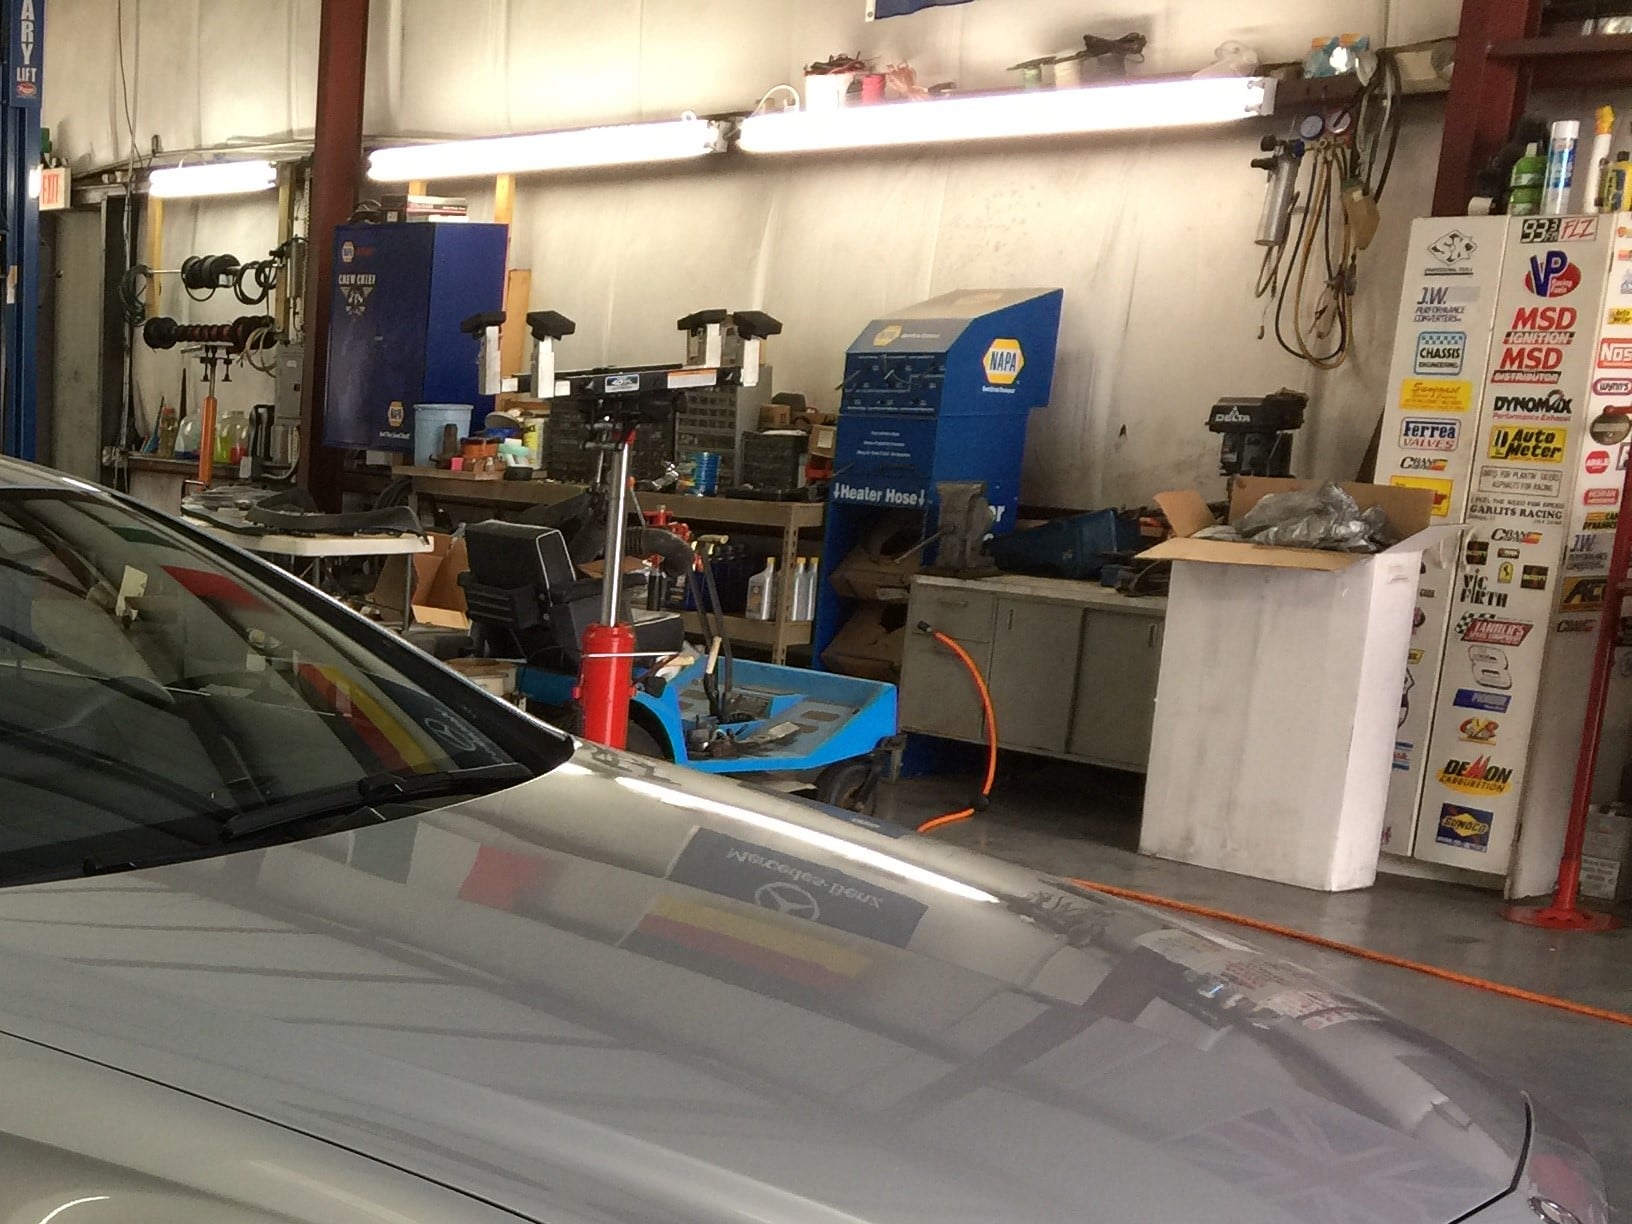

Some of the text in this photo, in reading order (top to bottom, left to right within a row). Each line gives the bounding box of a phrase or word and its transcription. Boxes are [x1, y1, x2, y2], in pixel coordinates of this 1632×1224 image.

[16, 67, 38, 82] LIFT
[42, 174, 59, 205] EXIT
[1529, 249, 1568, 298] VP
[1511, 306, 1578, 331] MSD
[1508, 332, 1570, 345] IGNITION
[989, 351, 1017, 372] NAPA
[1419, 347, 1461, 359] CHASSIS
[1499, 347, 1563, 370] MSD
[1493, 390, 1574, 414] DYNOMAX
[1215, 411, 1251, 423] DELTA
[1403, 420, 1457, 439] Ferrea
[1511, 428, 1556, 444] Auto
[1403, 438, 1455, 449] VALVES
[1506, 443, 1562, 459] Meter
[841, 484, 918, 505] Heater Hose
[1470, 504, 1562, 519] GARLITS RACING
[1460, 588, 1508, 608] FIRTH
[1443, 753, 1513, 784] DEMON
[1443, 817, 1487, 833] SUNOCO
